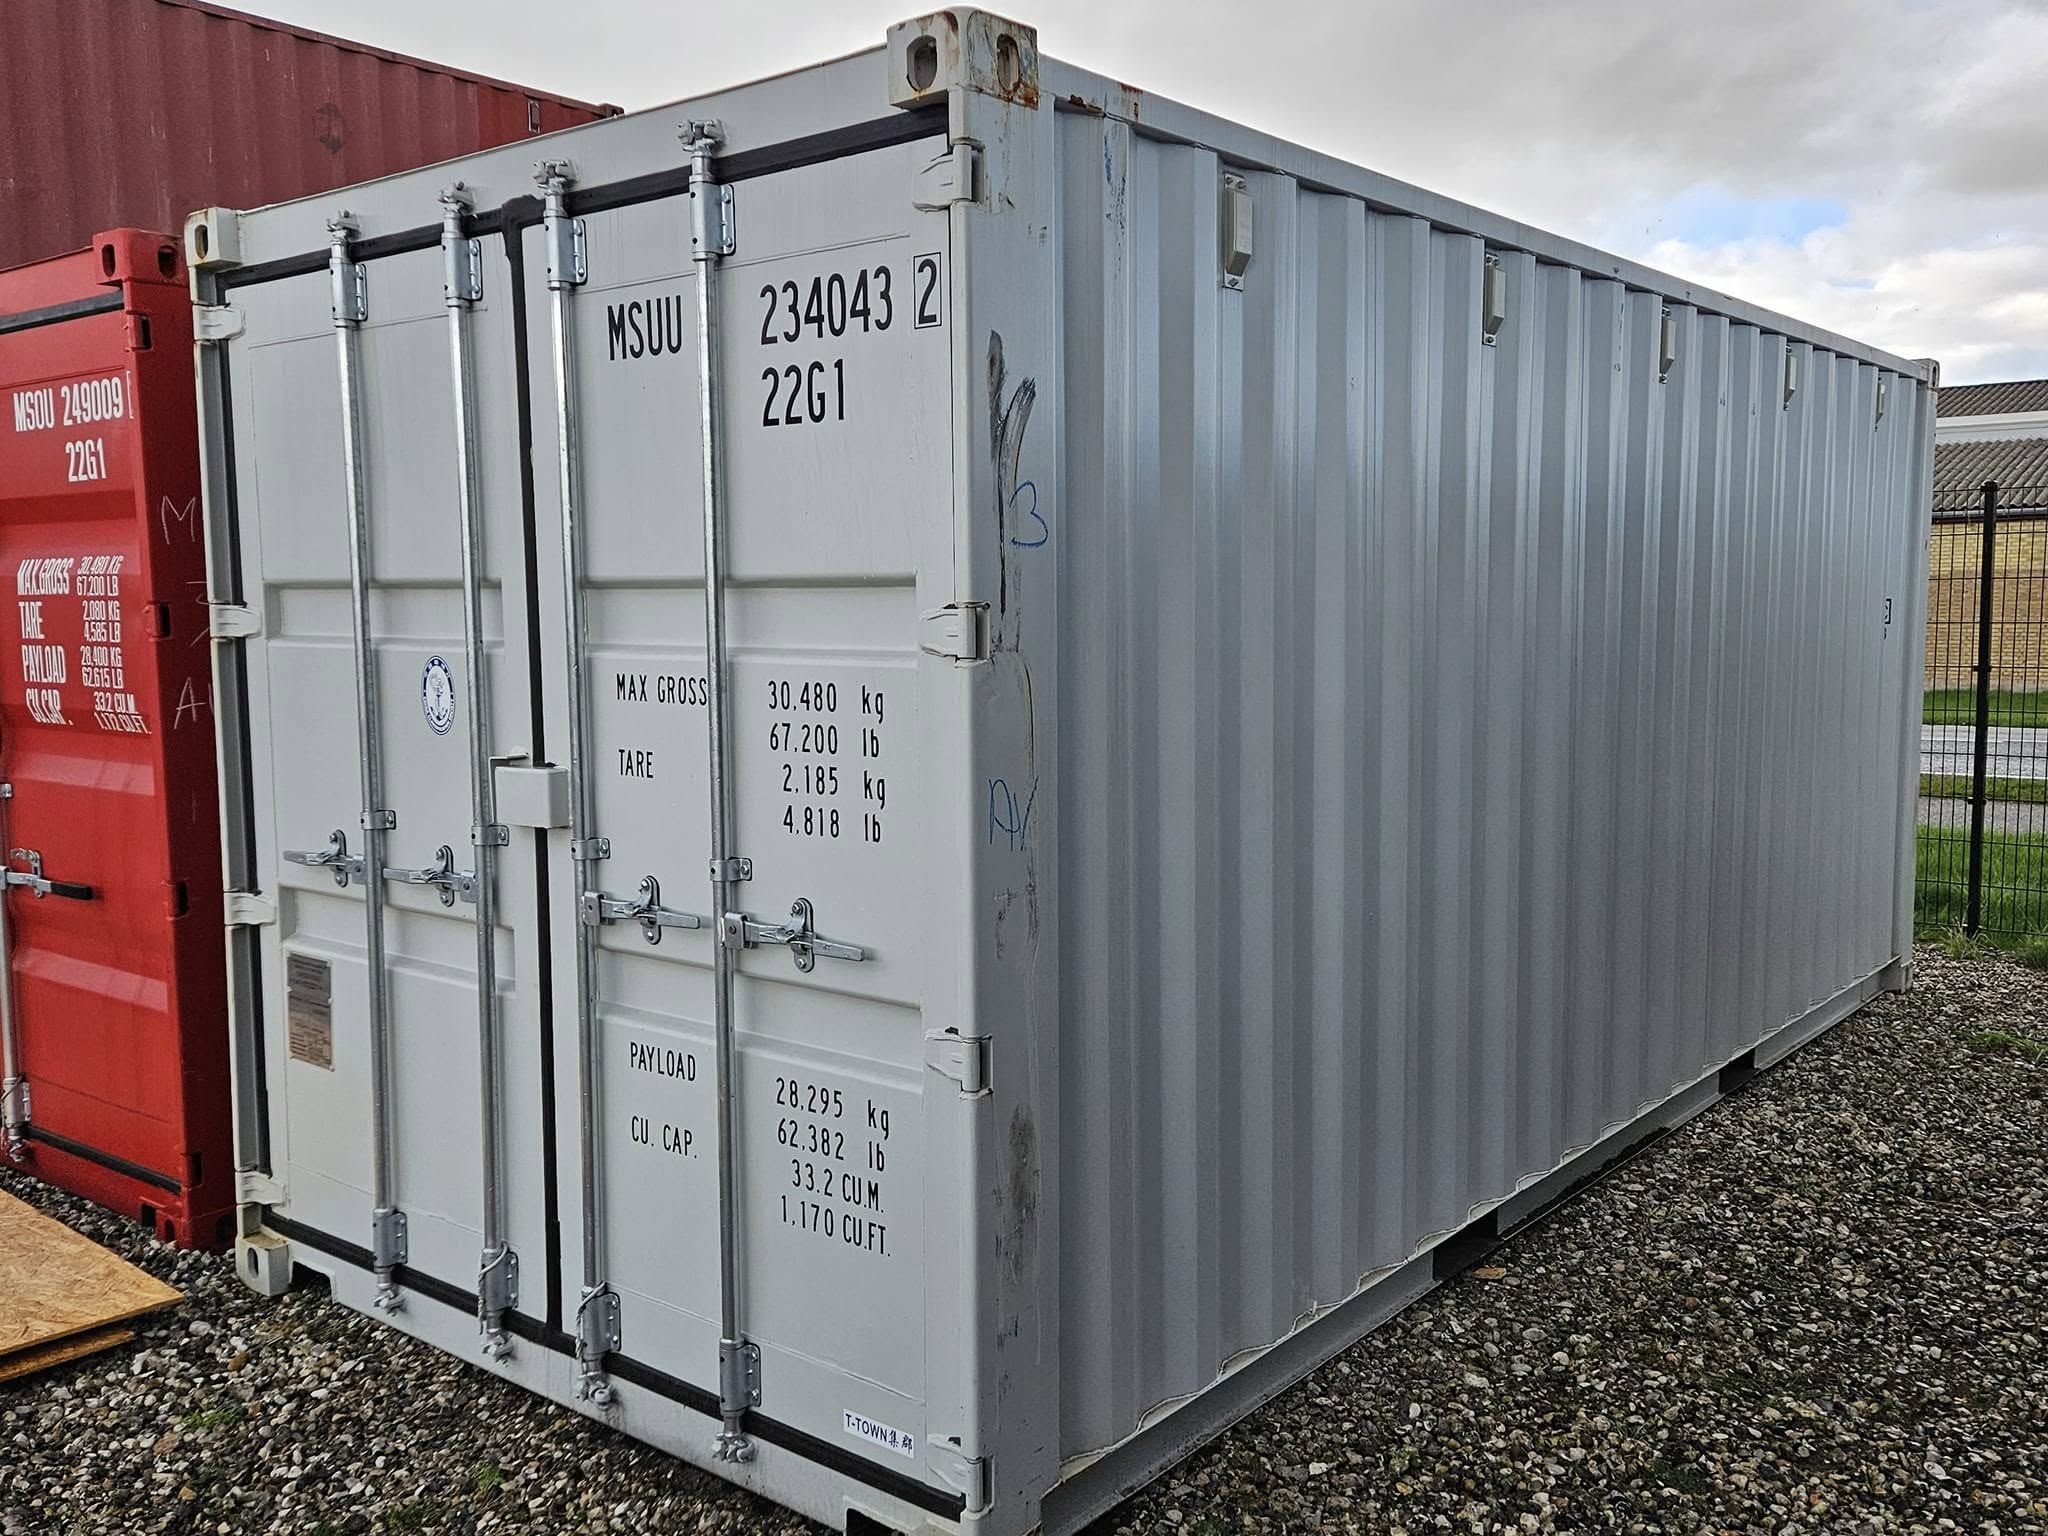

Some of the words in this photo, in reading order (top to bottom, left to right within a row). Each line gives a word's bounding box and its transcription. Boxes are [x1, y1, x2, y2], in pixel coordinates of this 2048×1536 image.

[607, 295, 682, 361] MSUU
[760, 265, 893, 345] 234043
[916, 257, 938, 325] 2
[13, 387, 55, 432] MSOU
[60, 376, 124, 426] 249009
[761, 358, 845, 427] 22G1
[65, 437, 106, 482] 22G1
[106, 575, 119, 597] LB
[18, 601, 45, 640] TARE
[108, 600, 121, 621] KG
[109, 621, 121, 643] LB
[21, 645, 67, 684] PAYLOAD
[110, 646, 123, 667] KG
[112, 668, 124, 689] LB
[616, 673, 648, 702] MAX
[657, 676, 707, 706] GROSS
[862, 684, 884, 724] kg
[862, 728, 880, 758] lb
[618, 749, 654, 779] TARE
[863, 770, 886, 810] kg
[864, 813, 881, 843] lb
[630, 1041, 697, 1082] PAYLOAD
[867, 1099, 890, 1141] kg
[631, 1115, 655, 1147] CU.
[662, 1124, 698, 1160] CAP.
[868, 1140, 885, 1172] lb
[792, 1158, 833, 1198] 33.2
